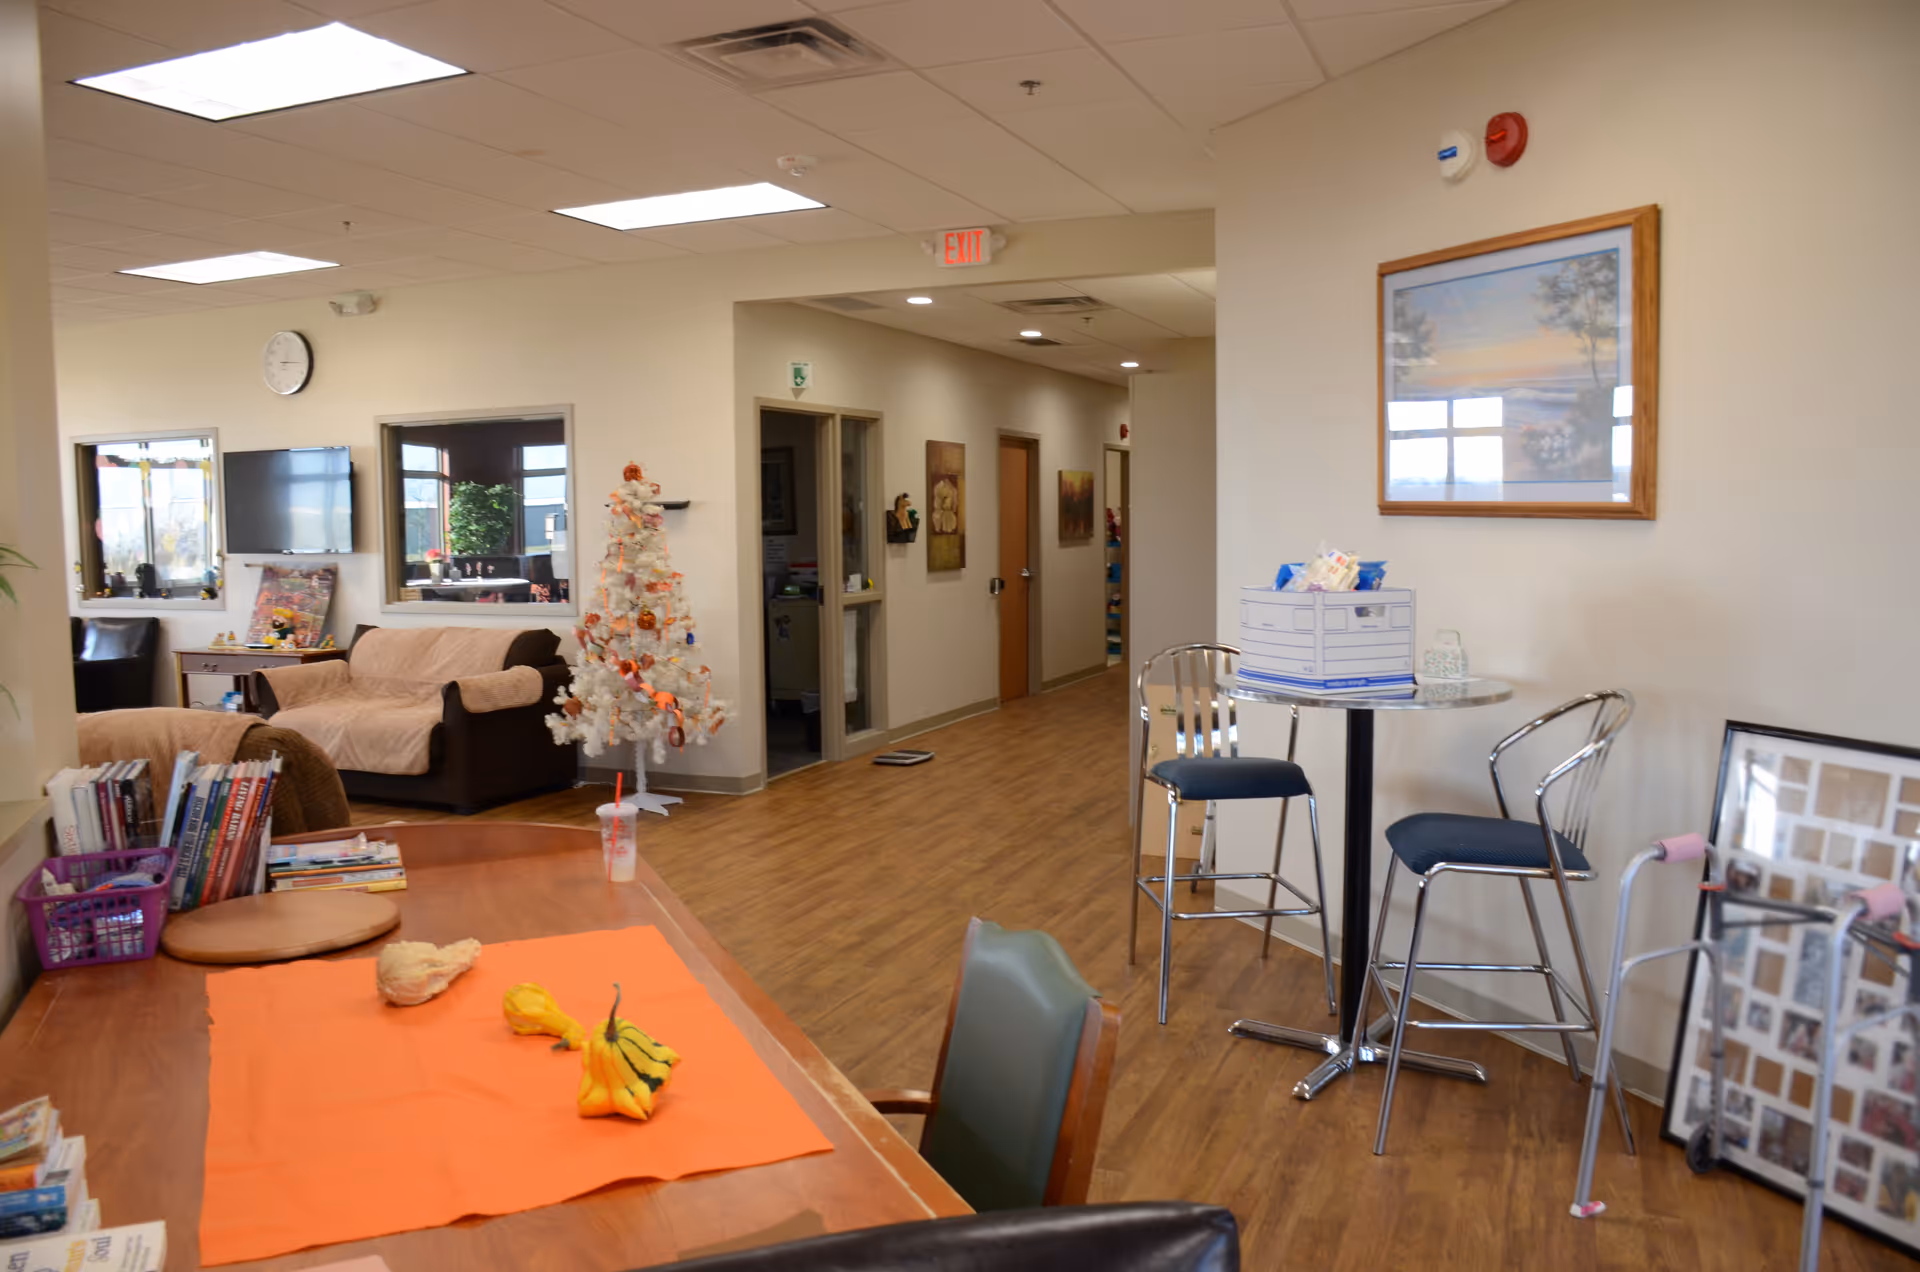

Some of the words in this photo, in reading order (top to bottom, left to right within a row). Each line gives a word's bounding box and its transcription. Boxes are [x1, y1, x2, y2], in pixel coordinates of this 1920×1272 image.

[944, 229, 984, 265] EXIT
[234, 781, 250, 811] LIVING
[86, 1236, 112, 1263] Soul
